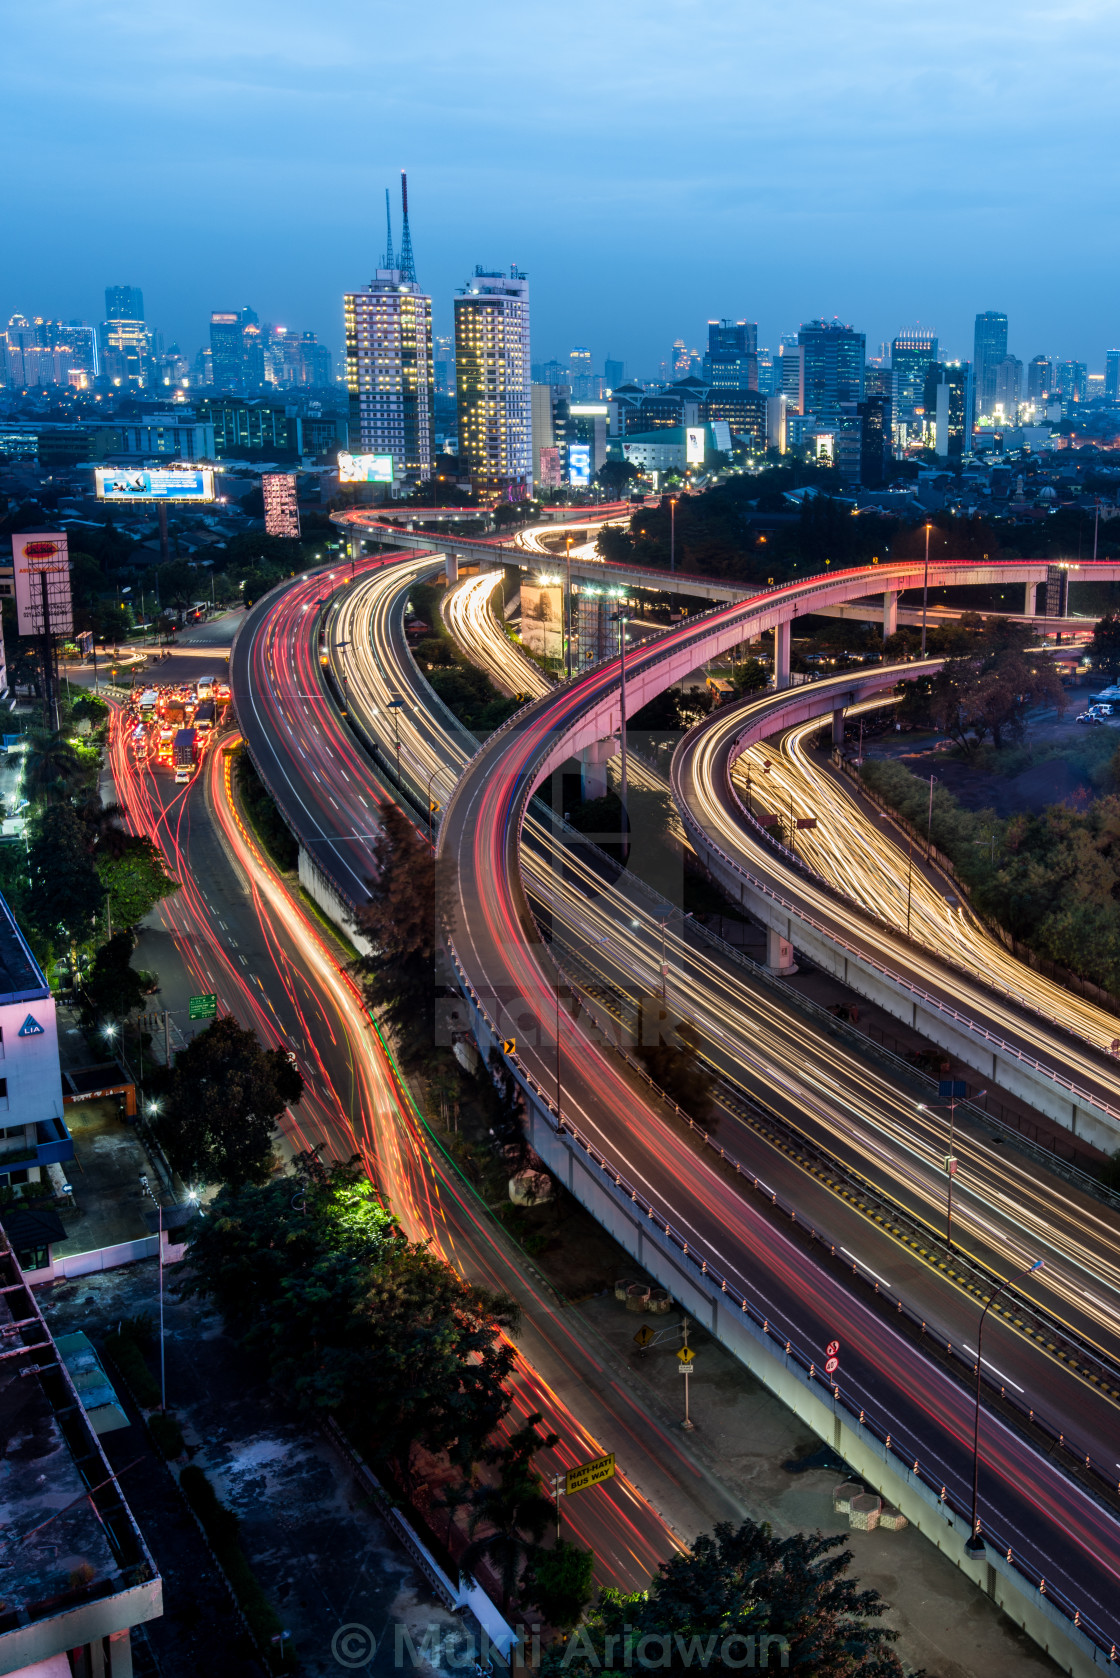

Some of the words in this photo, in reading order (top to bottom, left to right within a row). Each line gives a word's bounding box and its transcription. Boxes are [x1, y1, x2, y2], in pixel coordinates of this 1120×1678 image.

[24, 1026, 41, 1034] LIA
[569, 1457, 612, 1481] HATI-HATI
[570, 1477, 589, 1490] BUS
[591, 1467, 610, 1481] WAY
